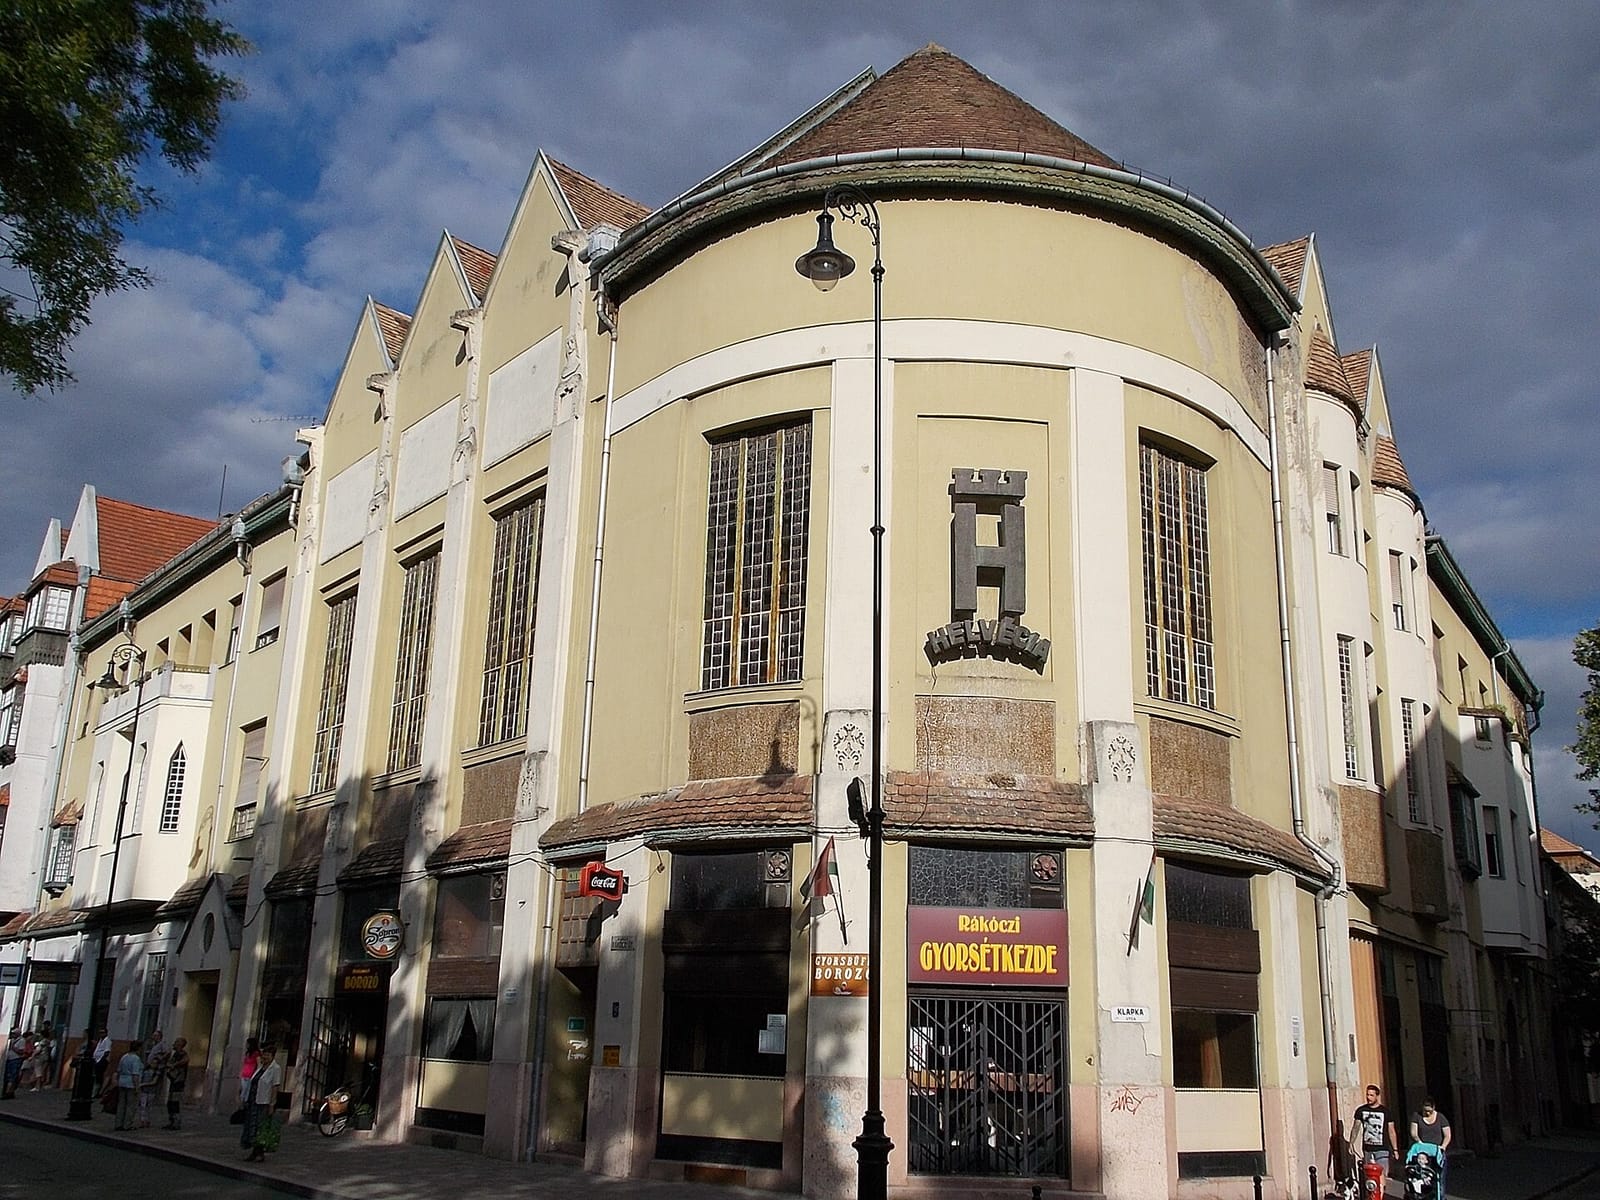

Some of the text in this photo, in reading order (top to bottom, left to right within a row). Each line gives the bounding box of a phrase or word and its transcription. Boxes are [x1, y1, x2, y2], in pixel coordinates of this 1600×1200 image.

[958, 914, 1021, 934] Rákóczi
[366, 926, 400, 945] Sopron
[815, 955, 870, 966] GYORSBÜF
[919, 936, 1058, 974] GYORSÉTKEZDE
[1117, 1008, 1144, 1016] KLAPKA
